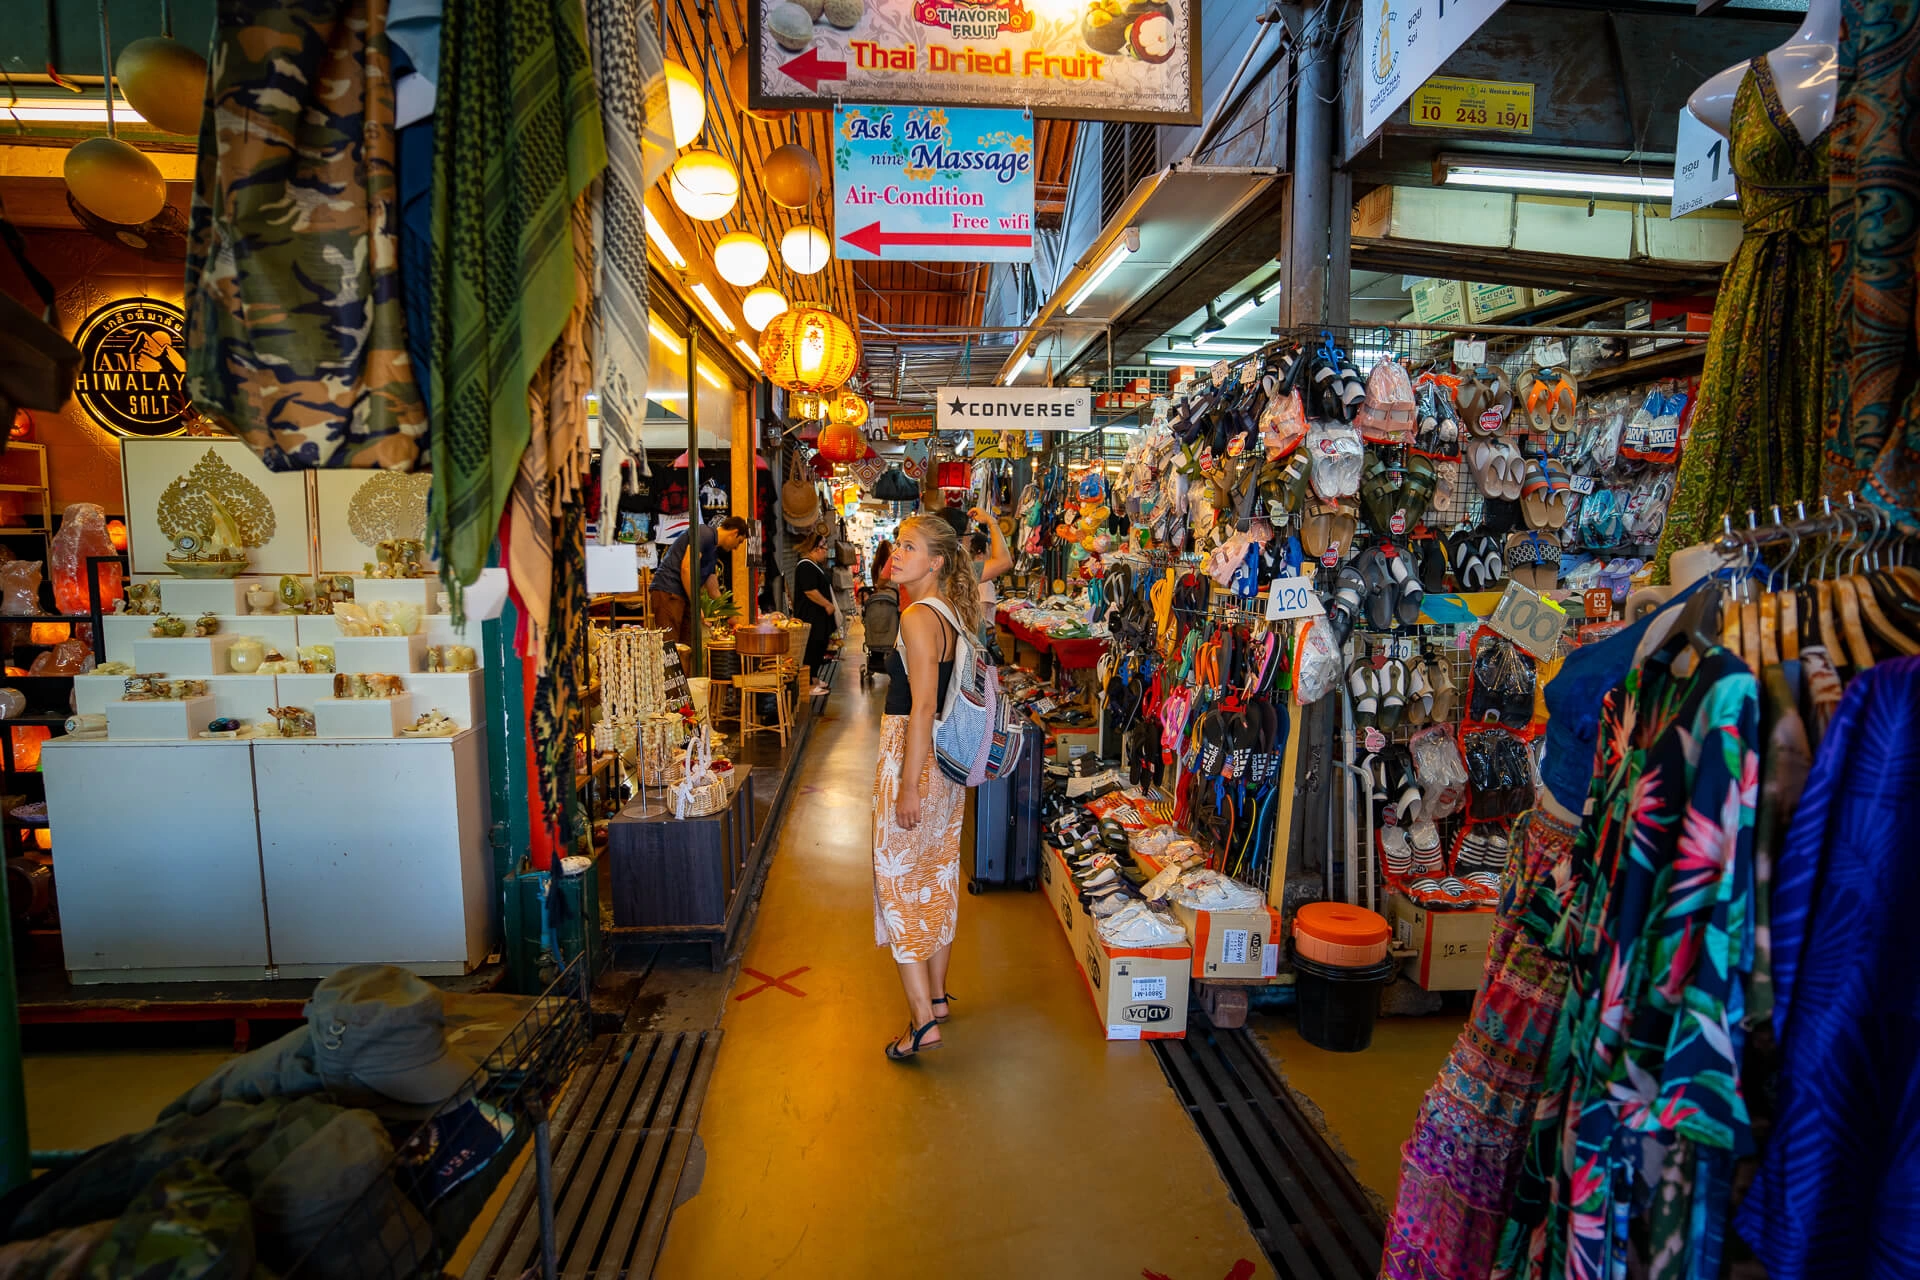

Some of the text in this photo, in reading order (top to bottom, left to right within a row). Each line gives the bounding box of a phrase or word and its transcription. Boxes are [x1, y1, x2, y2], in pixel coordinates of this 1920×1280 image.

[938, 8, 1010, 24] THAVORN
[952, 24, 998, 39] FRUIT
[1408, 32, 1419, 47] Soi
[850, 38, 1104, 81] Thai Dried Fruit
[1370, 73, 1401, 109] CHATUCHAK
[1421, 105, 1441, 120] 10
[1456, 108, 1488, 124] 243
[1496, 111, 1529, 129] 19/1
[851, 114, 942, 140] Ask Me
[871, 144, 1030, 184] nine Massage
[1682, 160, 1700, 175] ซอย
[845, 185, 984, 207] Air-Condition
[953, 213, 1030, 230] Free wifi
[97, 352, 140, 372] AM
[77, 373, 185, 390] HIMALAY
[129, 395, 169, 414] SALT
[969, 403, 1075, 417] CONVERSE
[1573, 475, 1592, 491] 170
[1276, 587, 1308, 612] 120
[1499, 589, 1560, 642] 100
[1250, 933, 1261, 959] ADDA
[1129, 1007, 1169, 1019] ADDA
